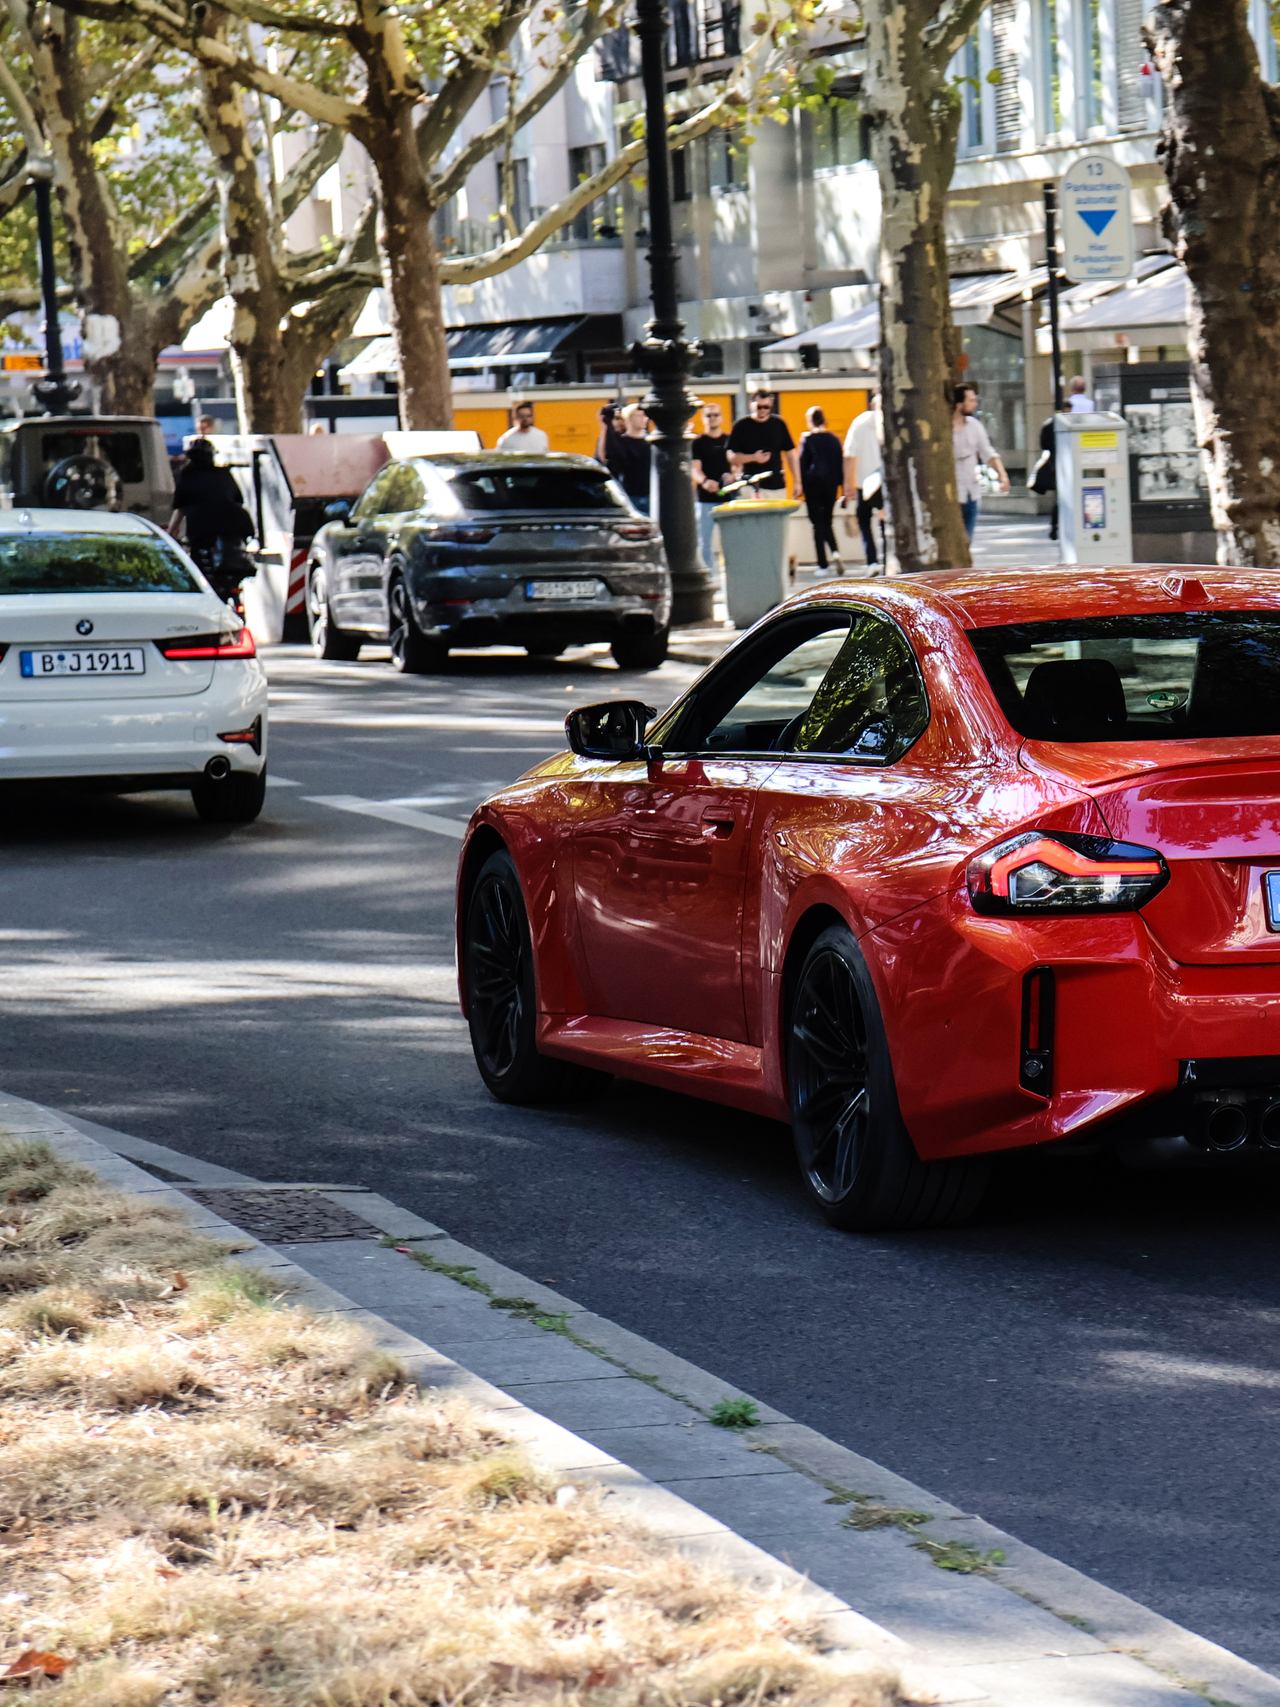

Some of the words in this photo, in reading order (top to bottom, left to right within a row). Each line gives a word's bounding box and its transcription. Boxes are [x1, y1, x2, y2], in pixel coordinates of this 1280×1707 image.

[1087, 163, 1104, 176] 13
[1075, 196, 1118, 205] automat
[1074, 255, 1123, 263] Parkschein
[42, 655, 54, 672] B
